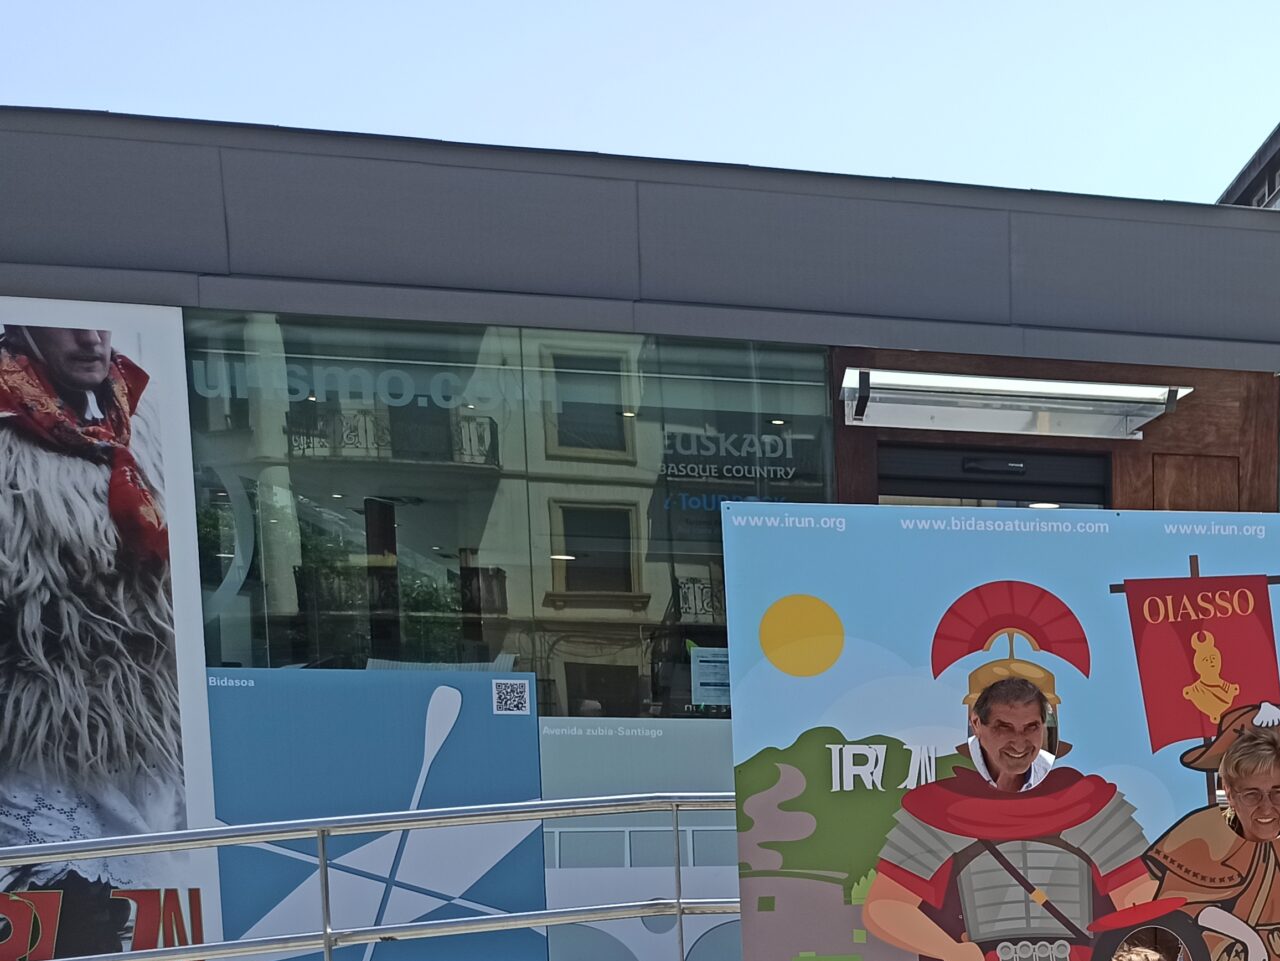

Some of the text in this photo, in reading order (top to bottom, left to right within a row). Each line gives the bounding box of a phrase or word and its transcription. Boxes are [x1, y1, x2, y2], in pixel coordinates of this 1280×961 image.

[663, 432, 793, 459] EUSKADI
[659, 463, 796, 480] BASQUE COUNTRY
[732, 513, 846, 532] www.irun.org
[901, 516, 1109, 534] www.bidasoaturismo.com
[1164, 521, 1266, 539] www.irun.org
[1143, 588, 1255, 624] OIASSO
[208, 676, 255, 688] Bidasoa
[542, 725, 664, 738] Avenida zubia-Santiago
[825, 744, 937, 792] IRUN
